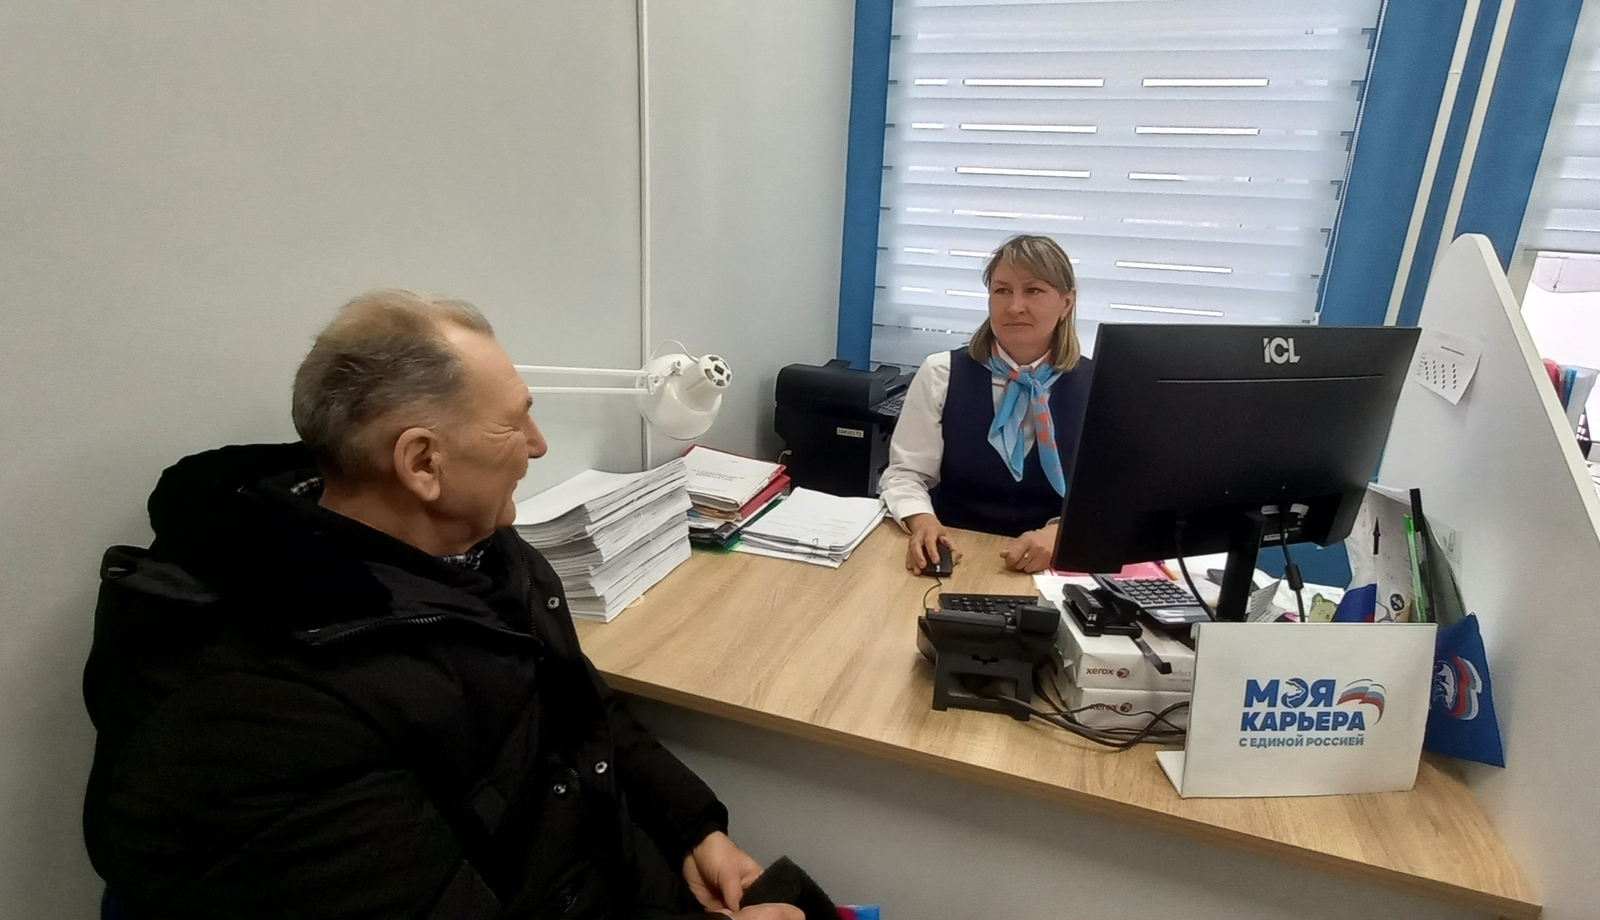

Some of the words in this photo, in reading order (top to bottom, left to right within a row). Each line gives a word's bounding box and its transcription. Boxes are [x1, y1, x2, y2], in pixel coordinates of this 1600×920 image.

[1085, 667, 1114, 676] xerox
[1240, 711, 1366, 732] КАРЬЕРА
[1239, 737, 1248, 747] С
[1250, 734, 1304, 749] ЕДИНОЙ
[1306, 733, 1364, 747] РОССИЕЙ
